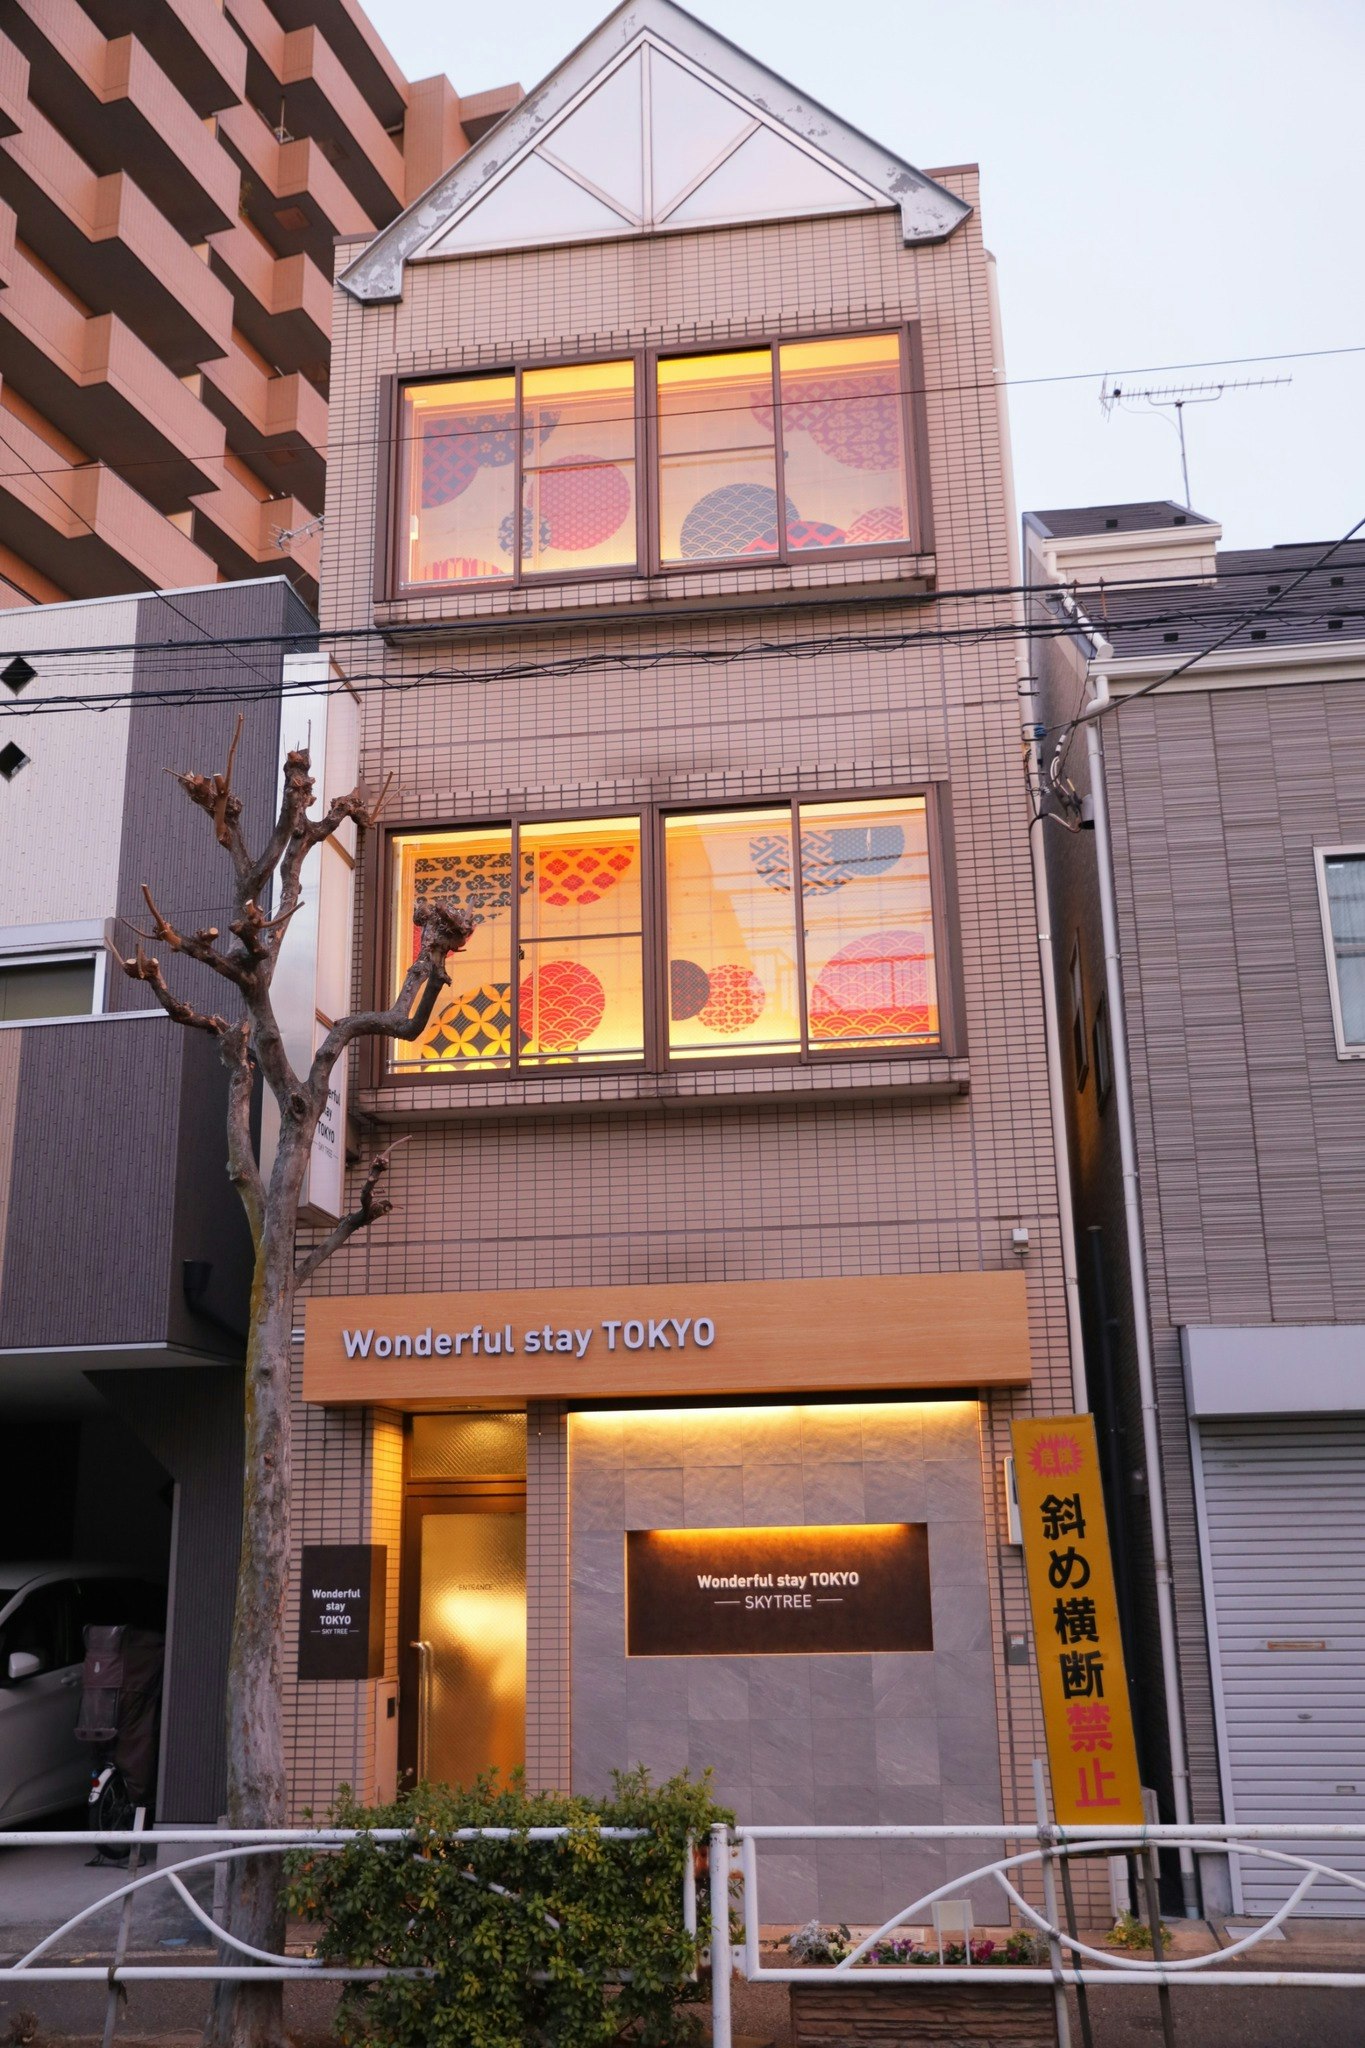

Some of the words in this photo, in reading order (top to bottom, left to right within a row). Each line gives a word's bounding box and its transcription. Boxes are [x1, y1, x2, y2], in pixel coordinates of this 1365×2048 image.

[318, 1121, 335, 1144] TOKYO
[342, 1324, 515, 1359] Wonderful
[525, 1325, 593, 1358] stay
[601, 1317, 716, 1350] TOKYO
[697, 1574, 774, 1589] Wonderful
[777, 1574, 807, 1589] stay
[810, 1572, 859, 1586] TOKYO
[312, 1588, 361, 1599] Wonderful
[745, 1594, 812, 1609] SKYTREE
[325, 1601, 346, 1613] stay
[320, 1615, 352, 1625] TOKYO
[1039, 1493, 1121, 1808] 斜め横断禁止
